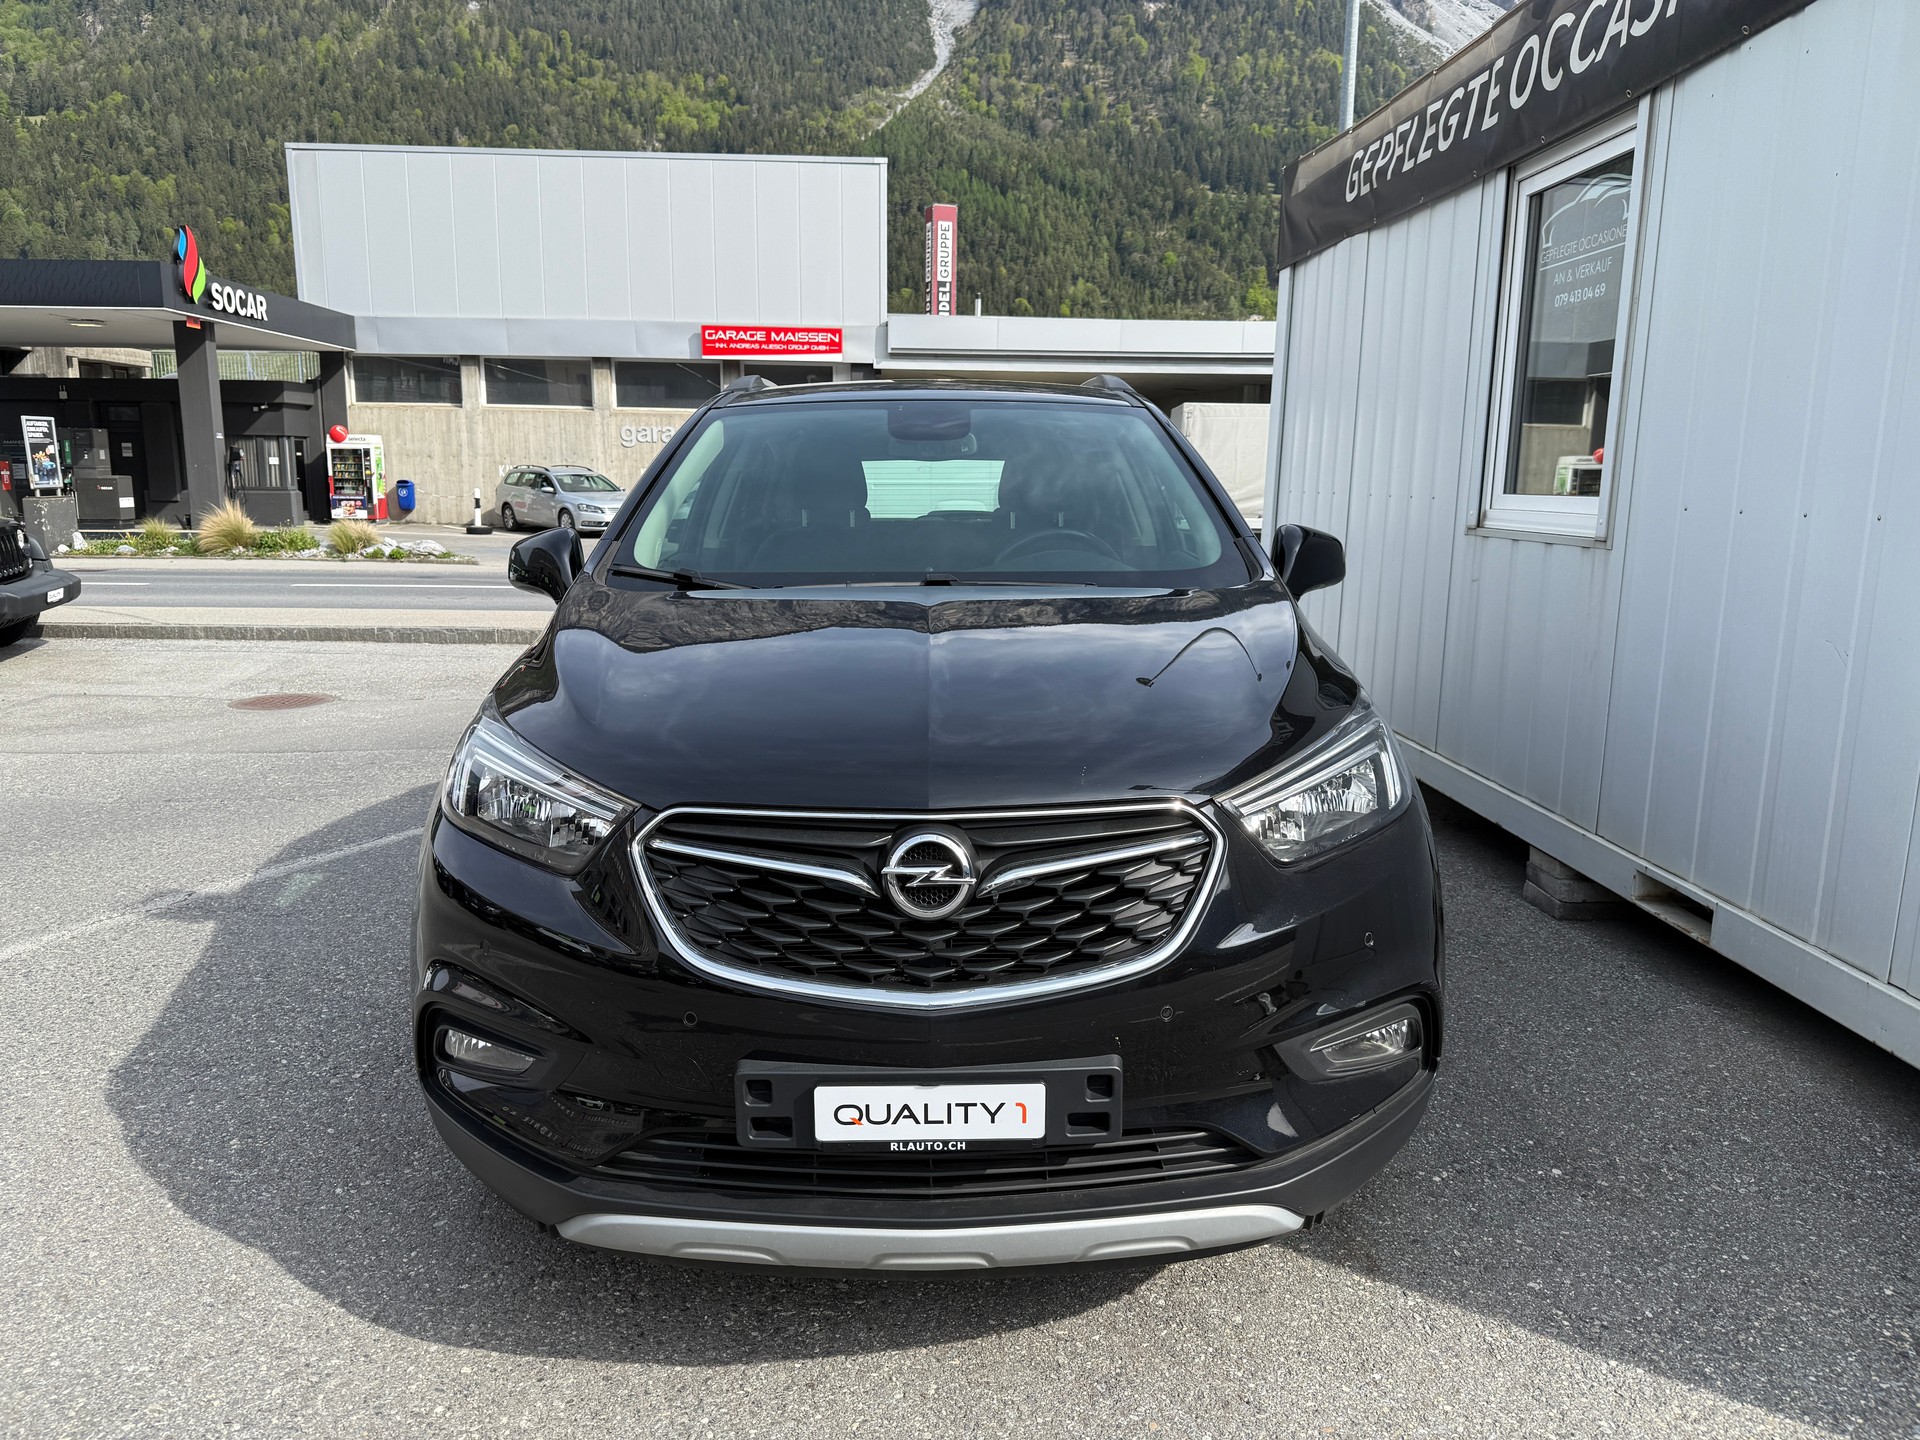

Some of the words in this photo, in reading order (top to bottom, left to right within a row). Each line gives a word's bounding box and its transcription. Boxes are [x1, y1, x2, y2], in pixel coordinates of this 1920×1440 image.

[1345, 56, 1505, 203] GEPFLEGTE
[1509, 0, 1677, 110] OCCA
[940, 224, 950, 279] GRUPPE
[1540, 241, 1578, 263] GEPFLEGTE
[1553, 270, 1565, 286] AN
[1567, 269, 1573, 282] &
[1575, 256, 1613, 279] VERKAUF
[211, 282, 268, 321] SOCAR
[1554, 292, 1568, 307] 079
[1569, 289, 1582, 303] 413
[1582, 286, 1593, 300] 04
[1595, 282, 1606, 297] 69
[705, 329, 767, 341] GARAGE
[770, 331, 839, 343] MAISSEN
[833, 1102, 1006, 1126] QUALITY
[890, 1141, 966, 1151] RLAUTO.CH
